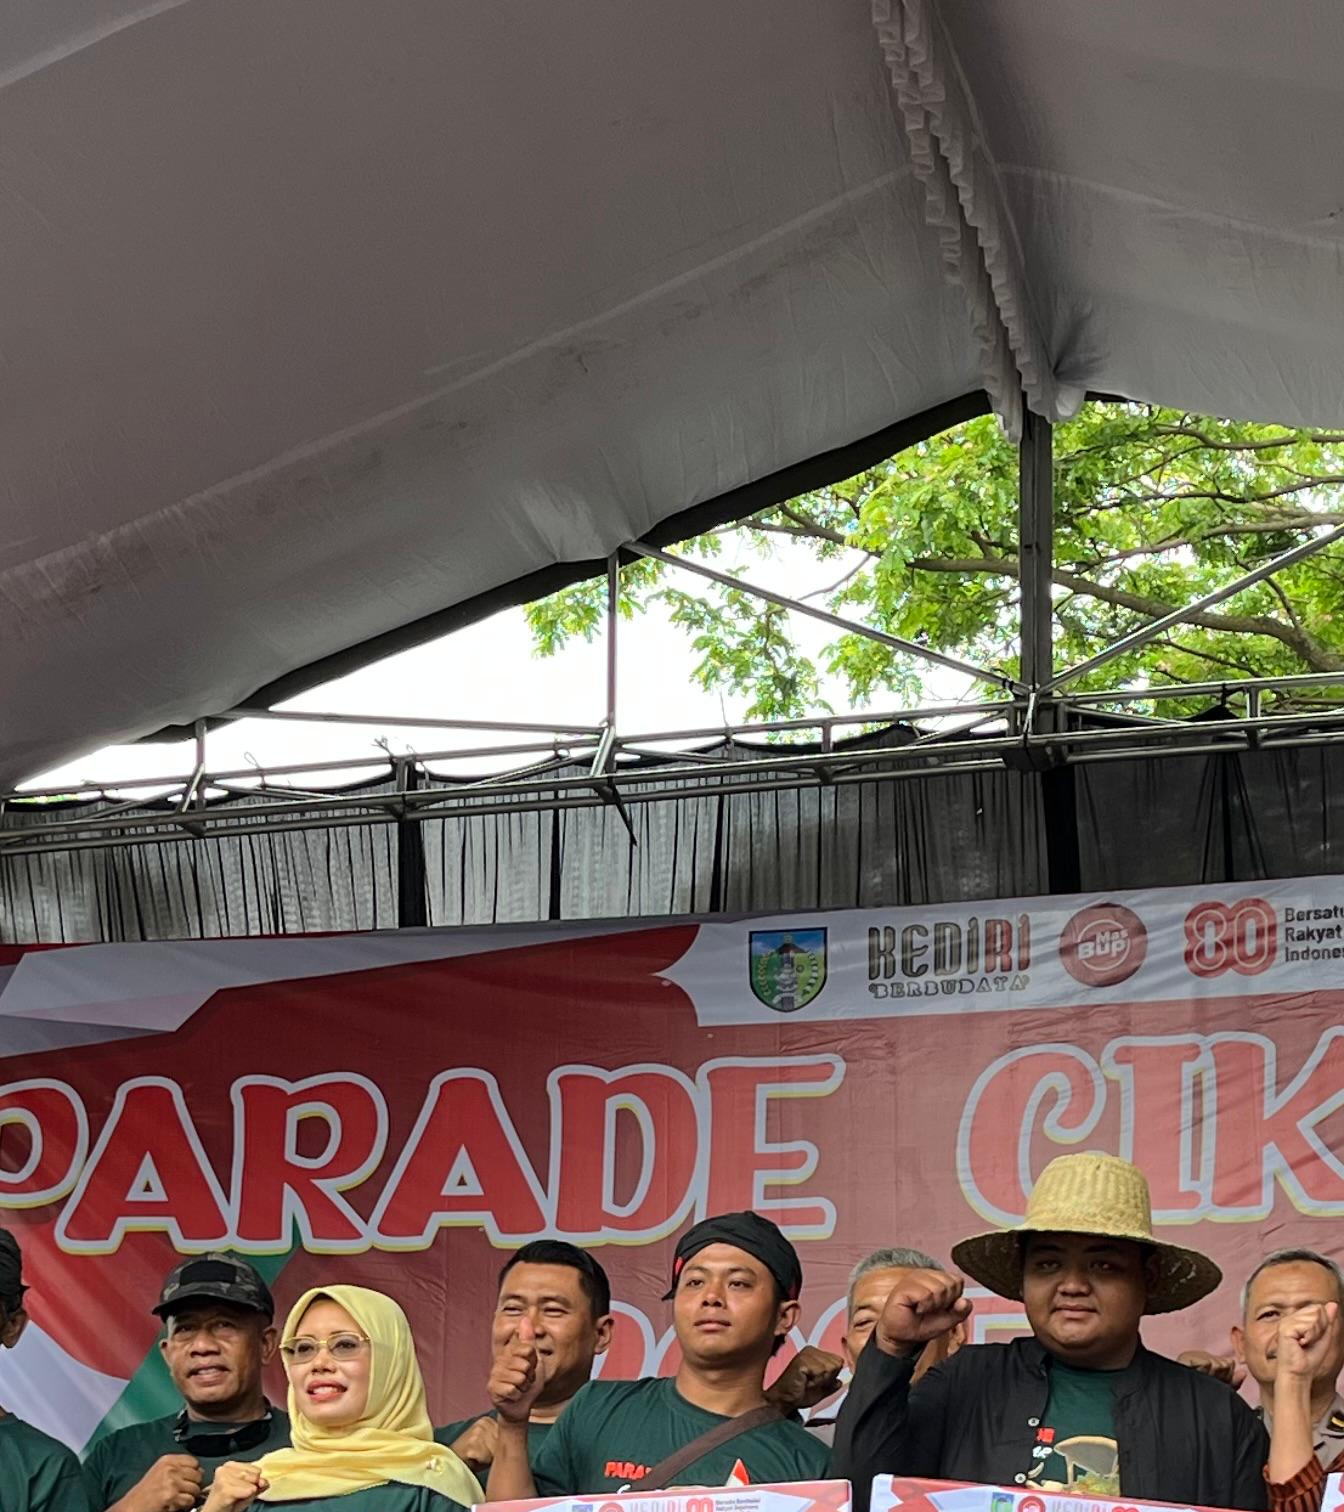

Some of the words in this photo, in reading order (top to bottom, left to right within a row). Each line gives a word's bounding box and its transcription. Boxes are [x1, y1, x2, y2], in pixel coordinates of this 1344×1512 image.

[1184, 898, 1277, 979] 80
[1284, 924, 1342, 944] Rakyat
[604, 1461, 653, 1481] PARA
